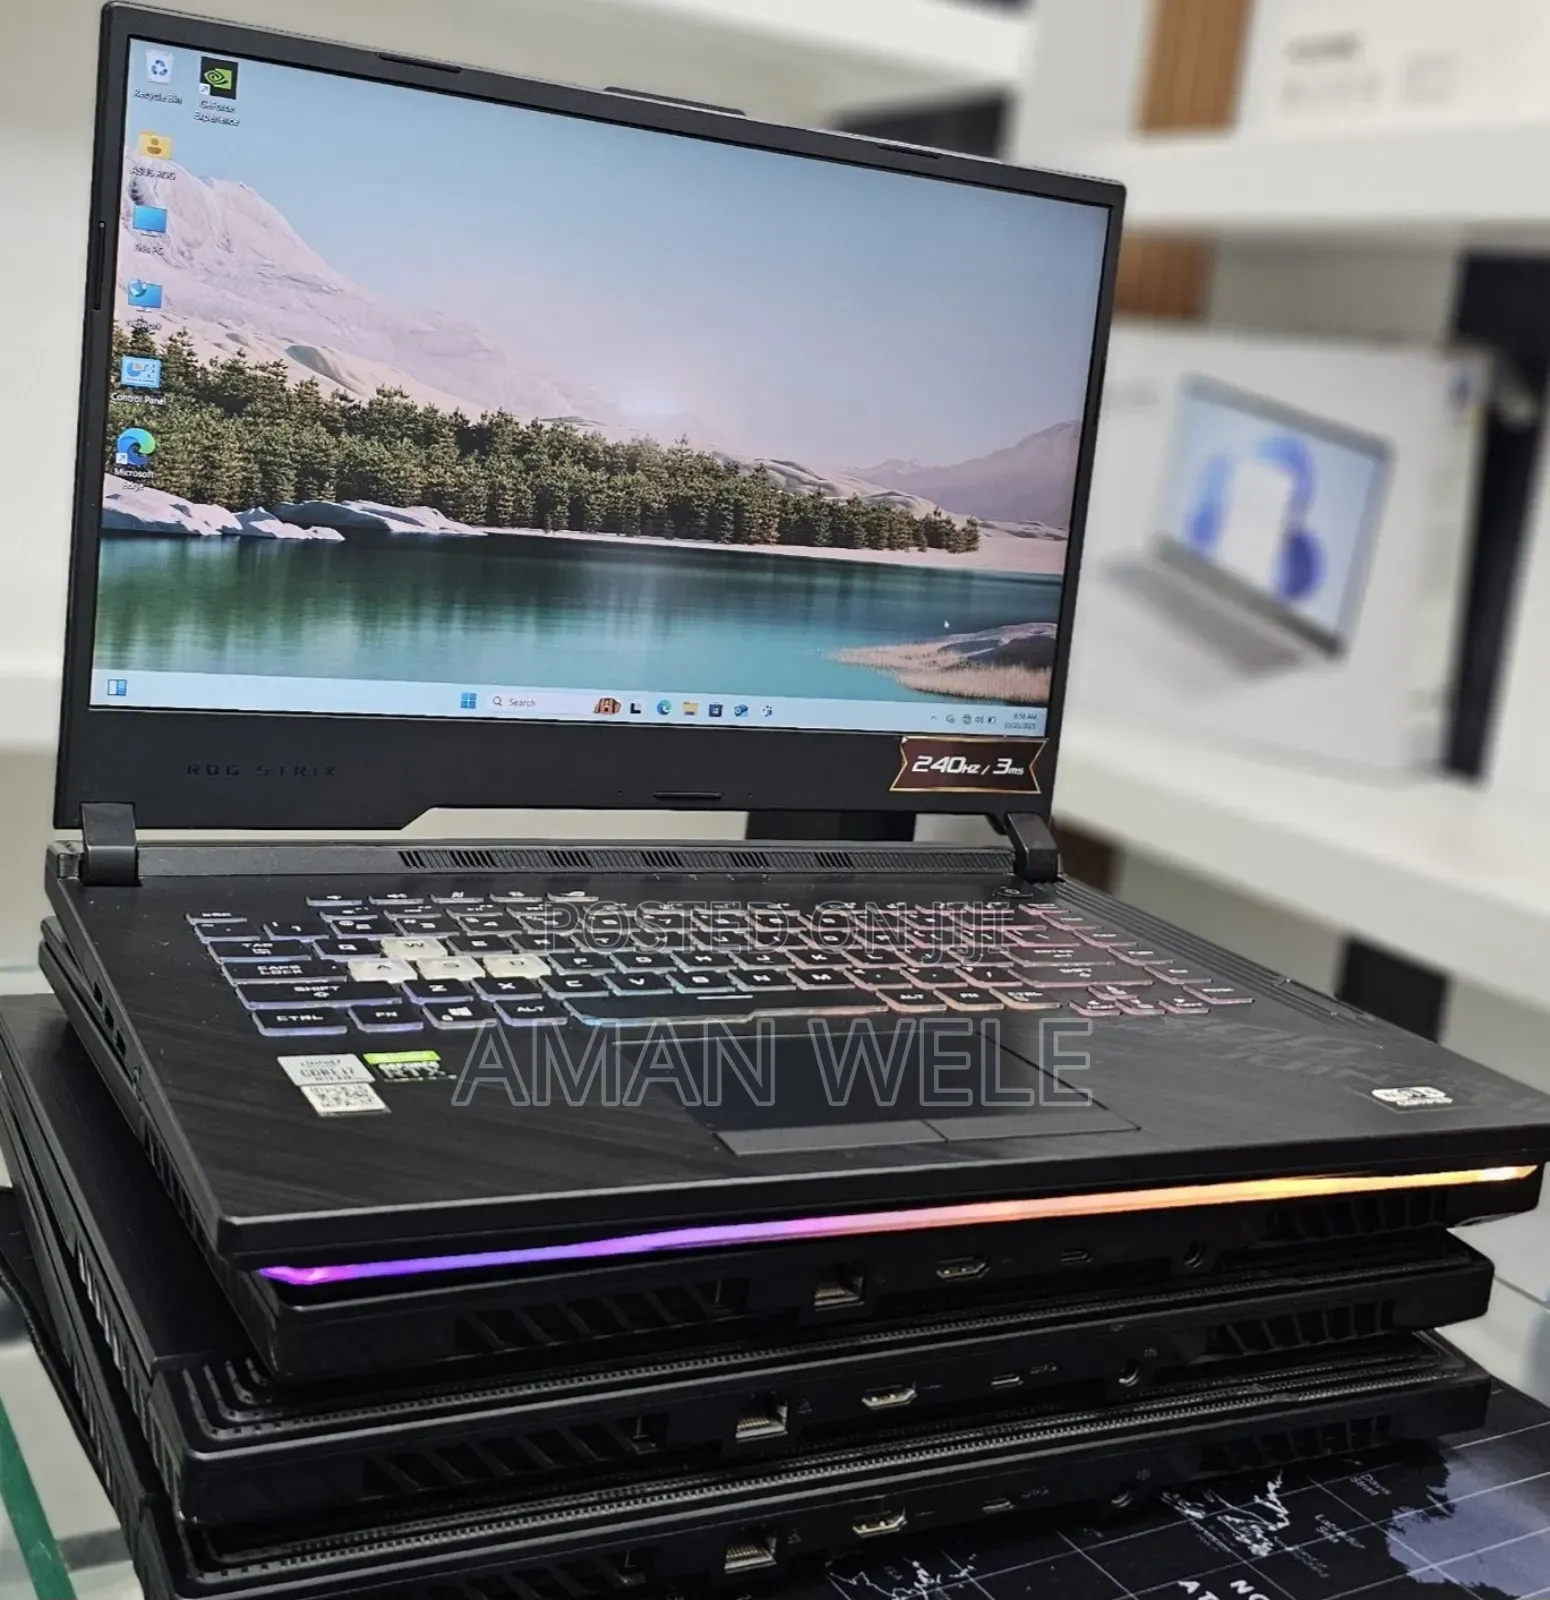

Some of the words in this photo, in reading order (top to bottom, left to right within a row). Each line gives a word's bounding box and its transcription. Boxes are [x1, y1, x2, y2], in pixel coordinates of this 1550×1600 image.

[110, 392, 143, 403] Control
[114, 467, 155, 479] Microsoft
[509, 697, 536, 708] Search
[186, 764, 240, 776] ROG
[256, 765, 335, 777] STRIX
[516, 1005, 546, 1013] ALT
[276, 1014, 324, 1022] CTRL
